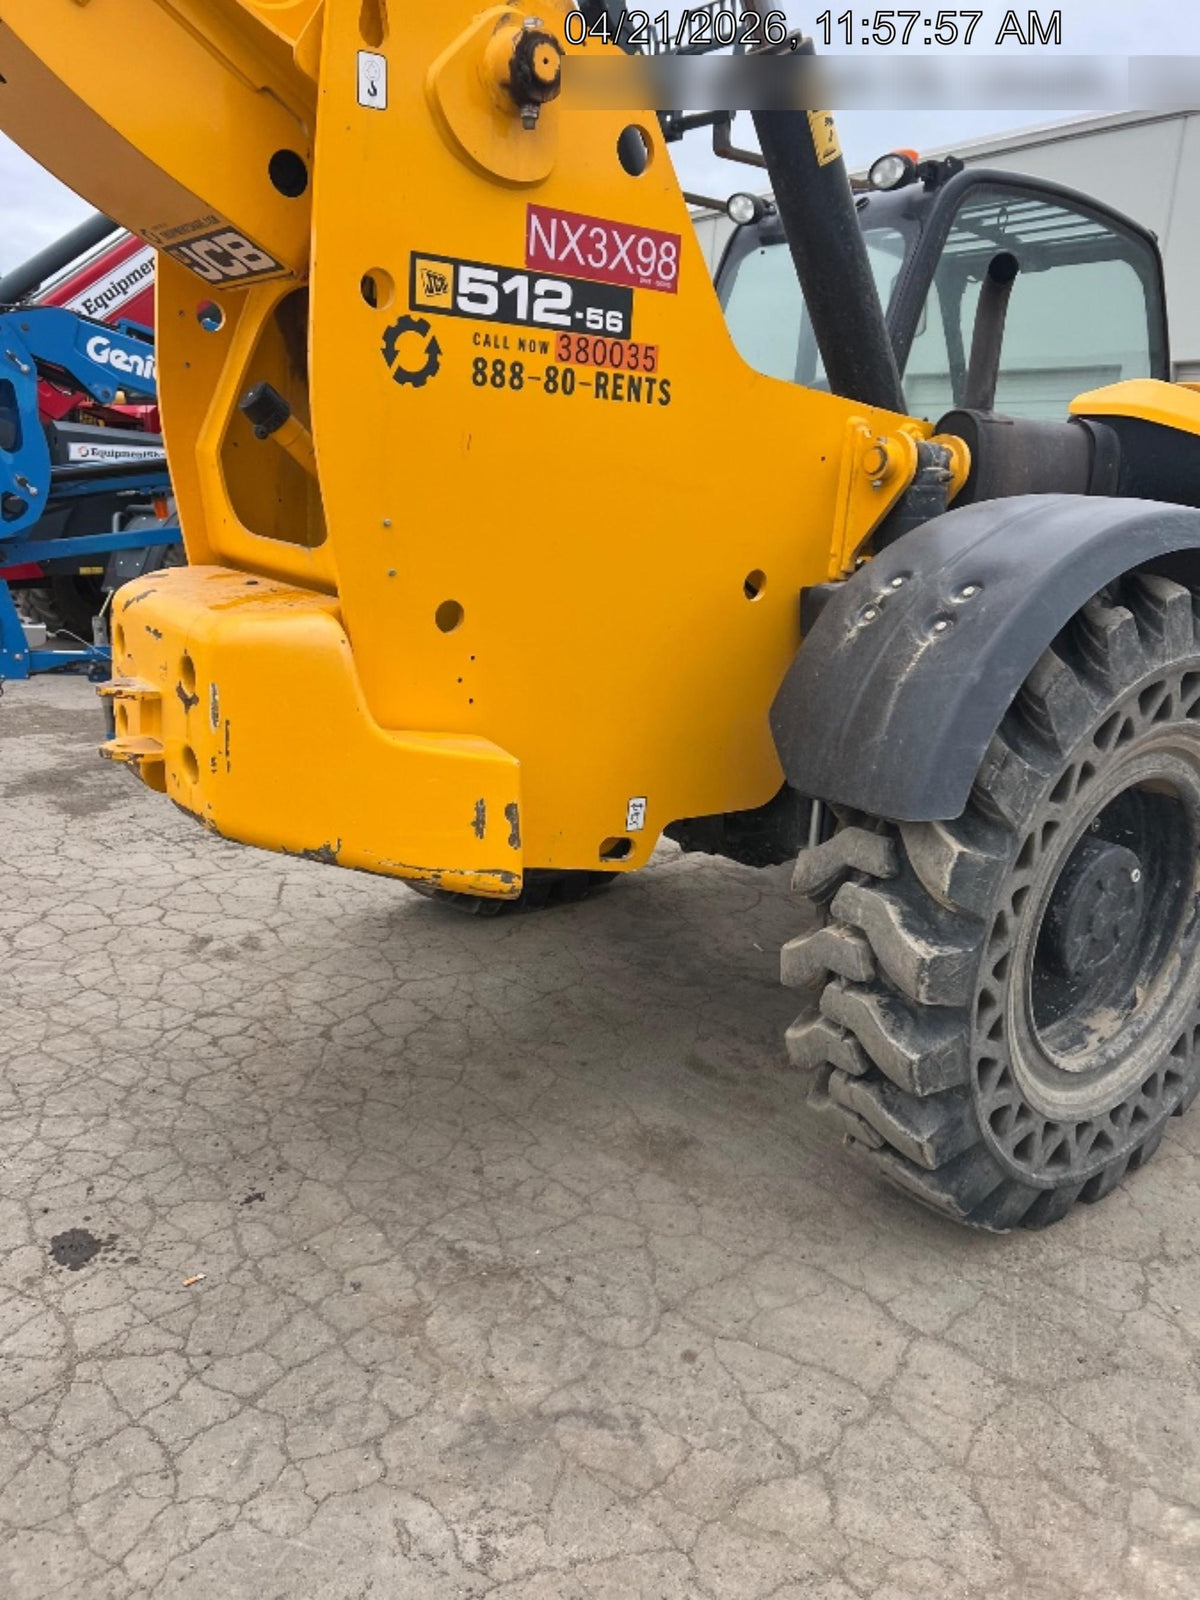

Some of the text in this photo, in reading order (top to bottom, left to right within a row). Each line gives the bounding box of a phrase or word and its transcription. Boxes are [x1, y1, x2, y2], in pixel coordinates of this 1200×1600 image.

[178, 231, 277, 281] JCB
[529, 213, 677, 281] NX3X98
[473, 332, 550, 355] CALL NOW
[557, 333, 656, 373] 380035
[472, 356, 672, 407] 888-80-RENTS
